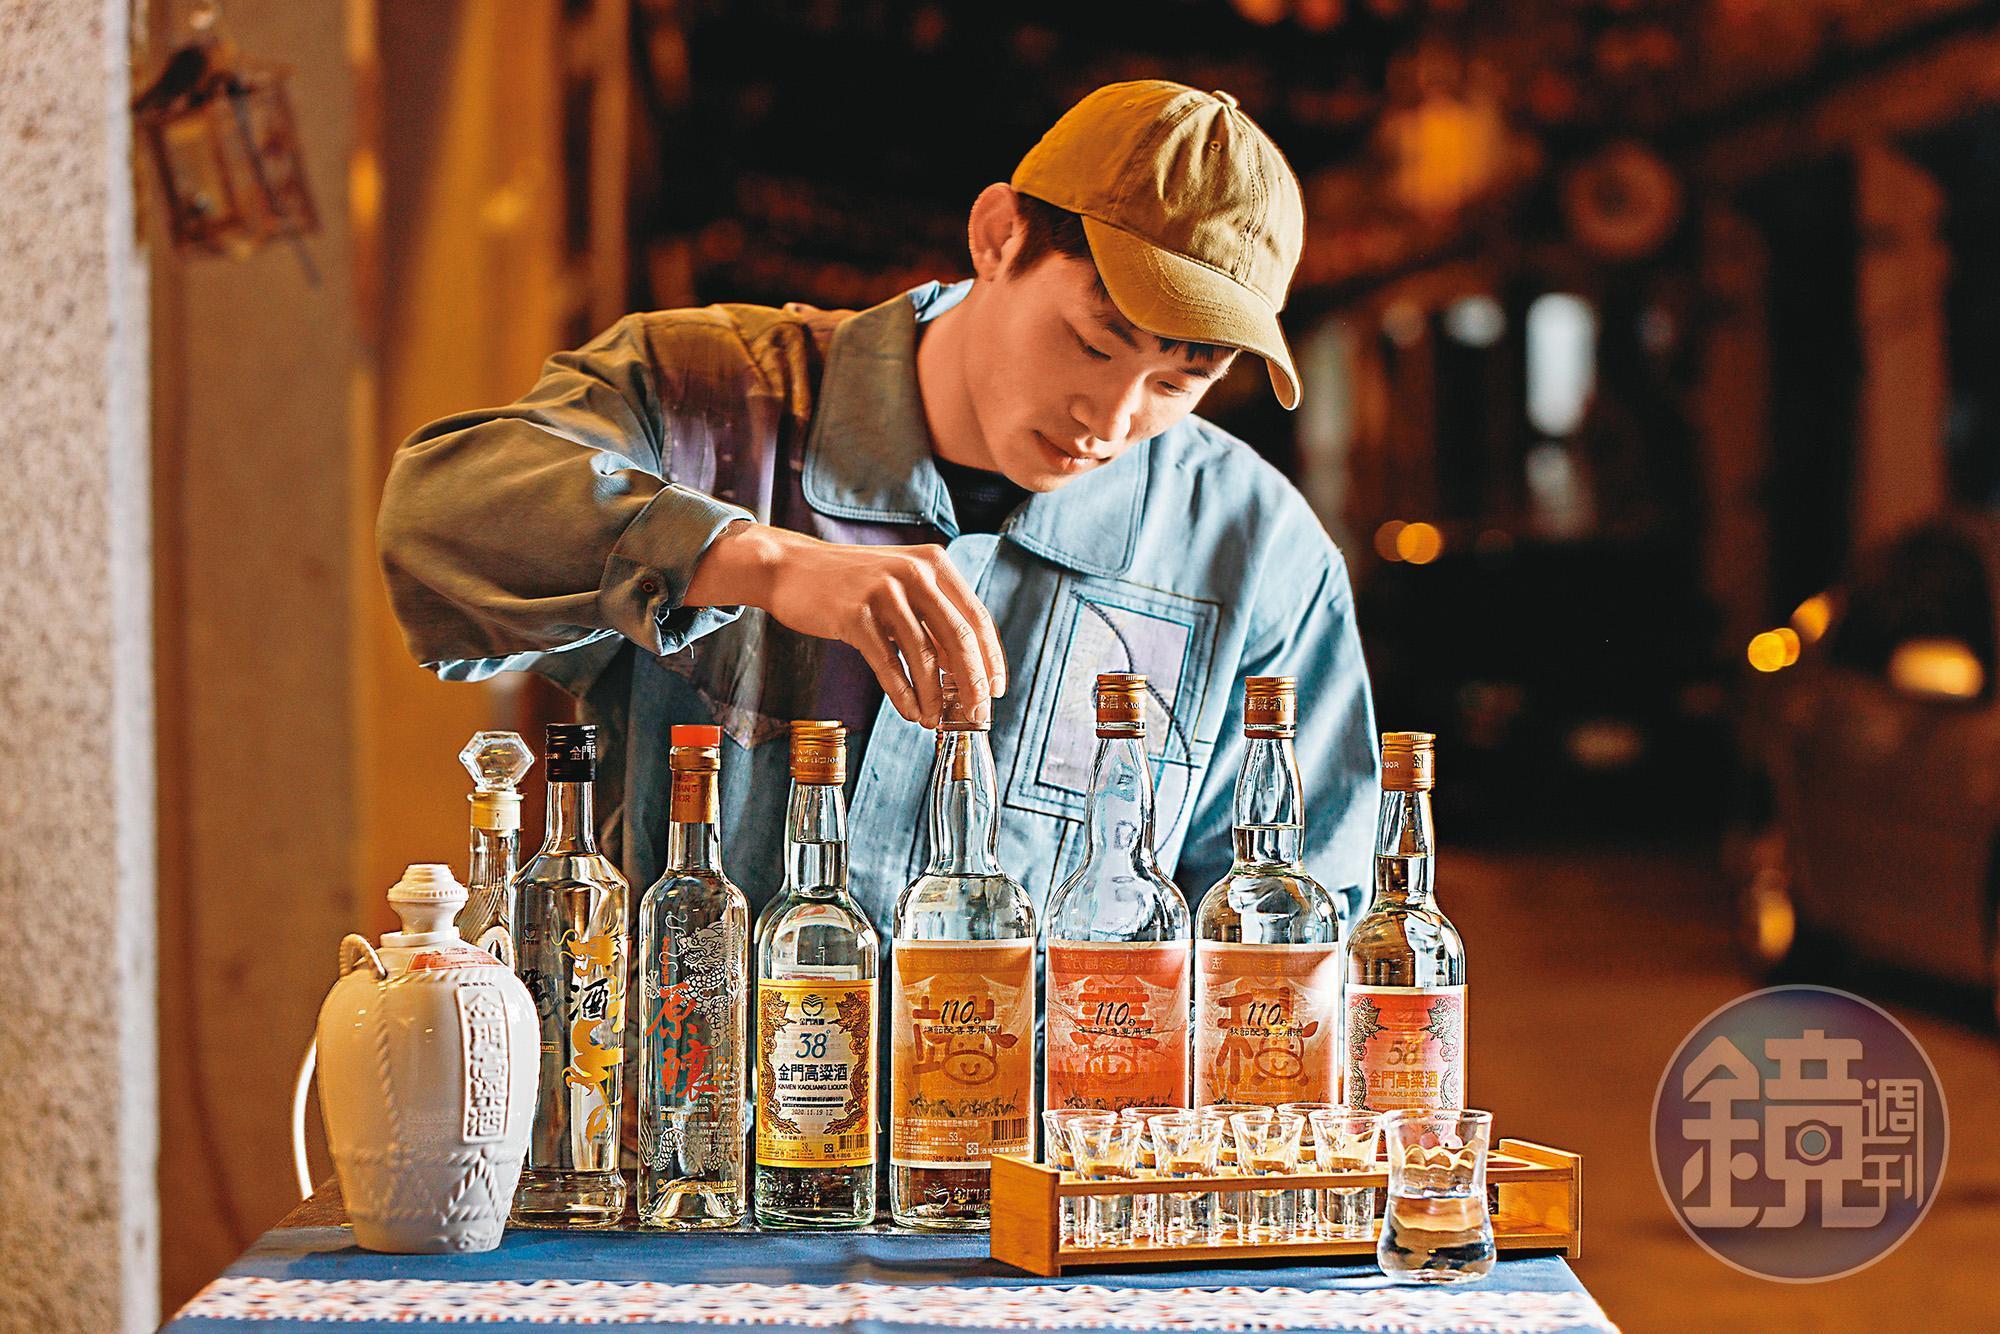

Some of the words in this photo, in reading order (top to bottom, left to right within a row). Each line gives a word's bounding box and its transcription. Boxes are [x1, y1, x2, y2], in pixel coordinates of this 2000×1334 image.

[778, 1063, 848, 1082] 金門高粱酒
[1368, 1070, 1439, 1089] 金門高粱酒
